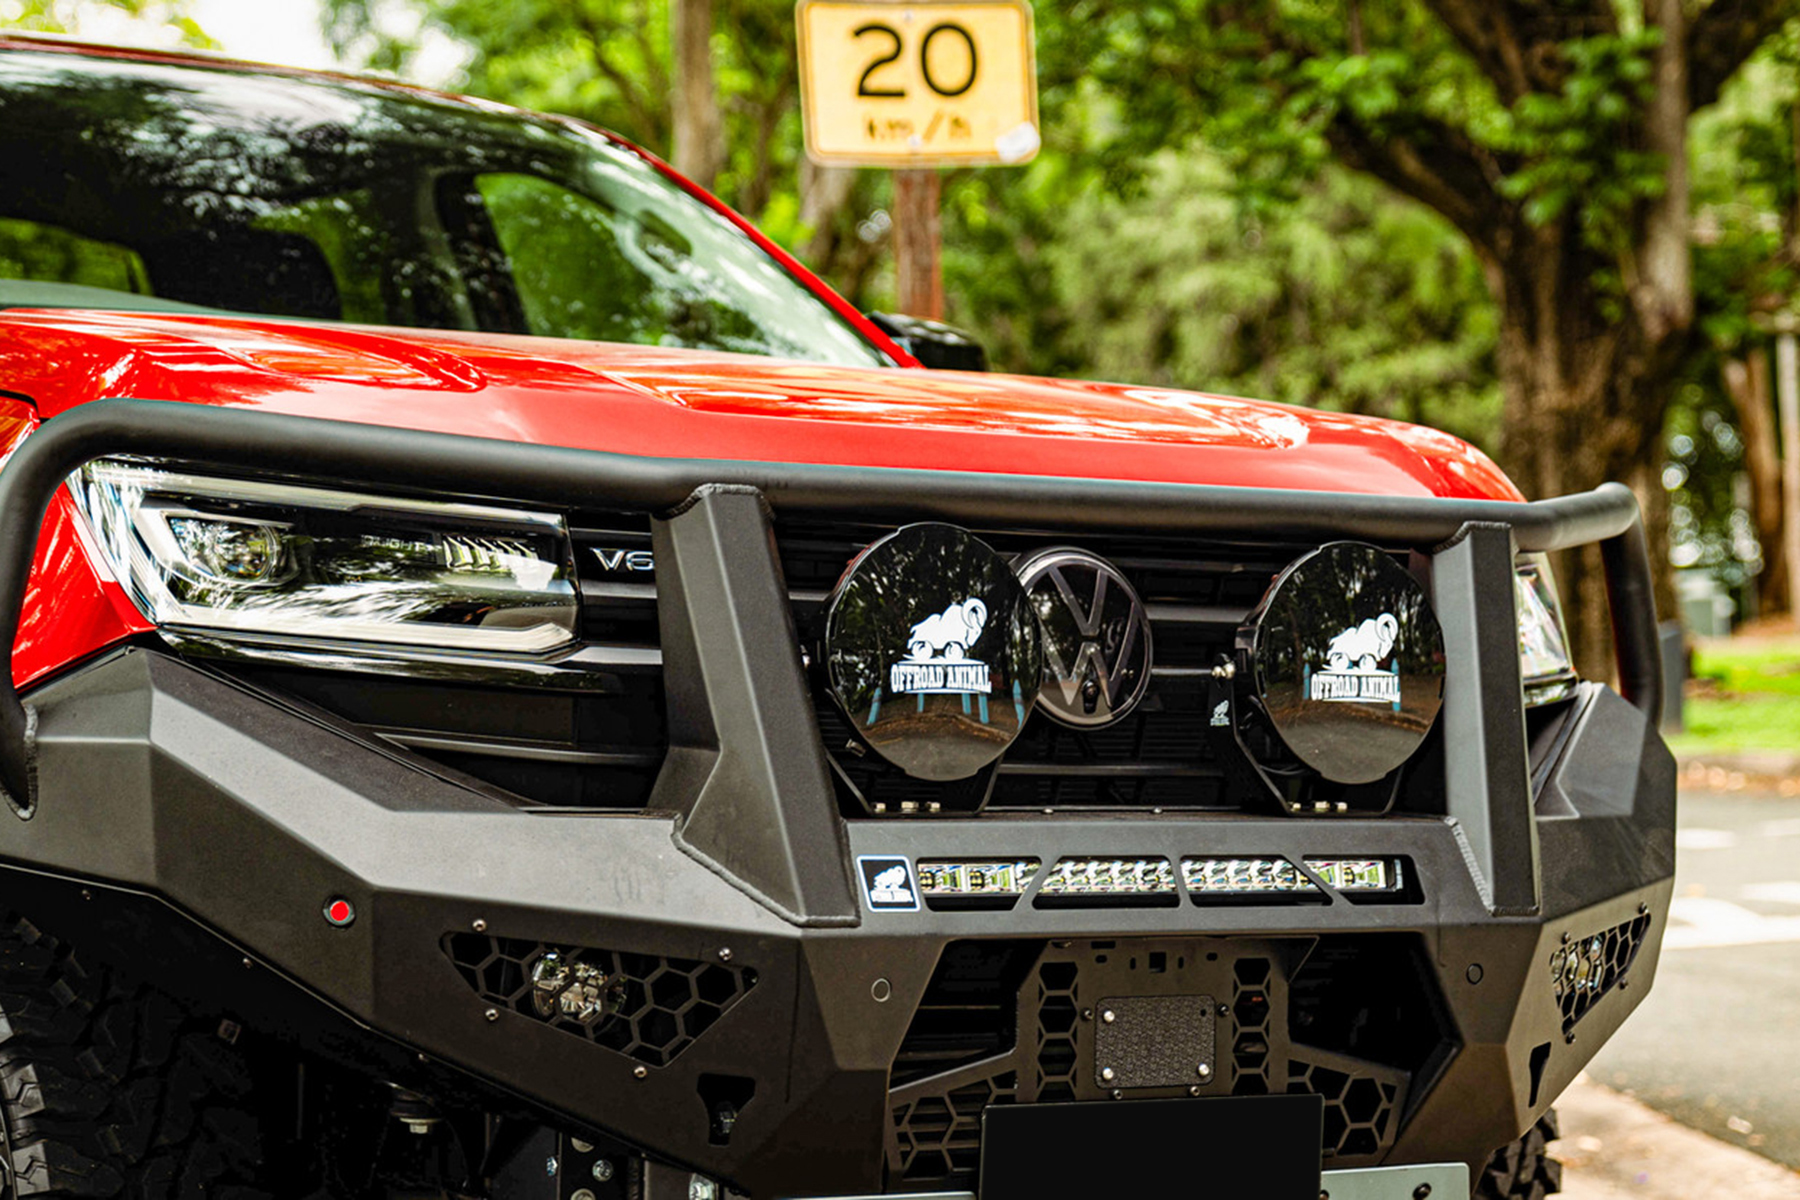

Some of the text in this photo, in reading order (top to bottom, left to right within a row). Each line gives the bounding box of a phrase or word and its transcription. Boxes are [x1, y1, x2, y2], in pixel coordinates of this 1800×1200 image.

[853, 24, 977, 97] 20
[589, 546, 655, 571] V6
[890, 663, 992, 694] OFFROAD ANIMAL
[1311, 673, 1401, 703] OFFROAD ANIMAL
